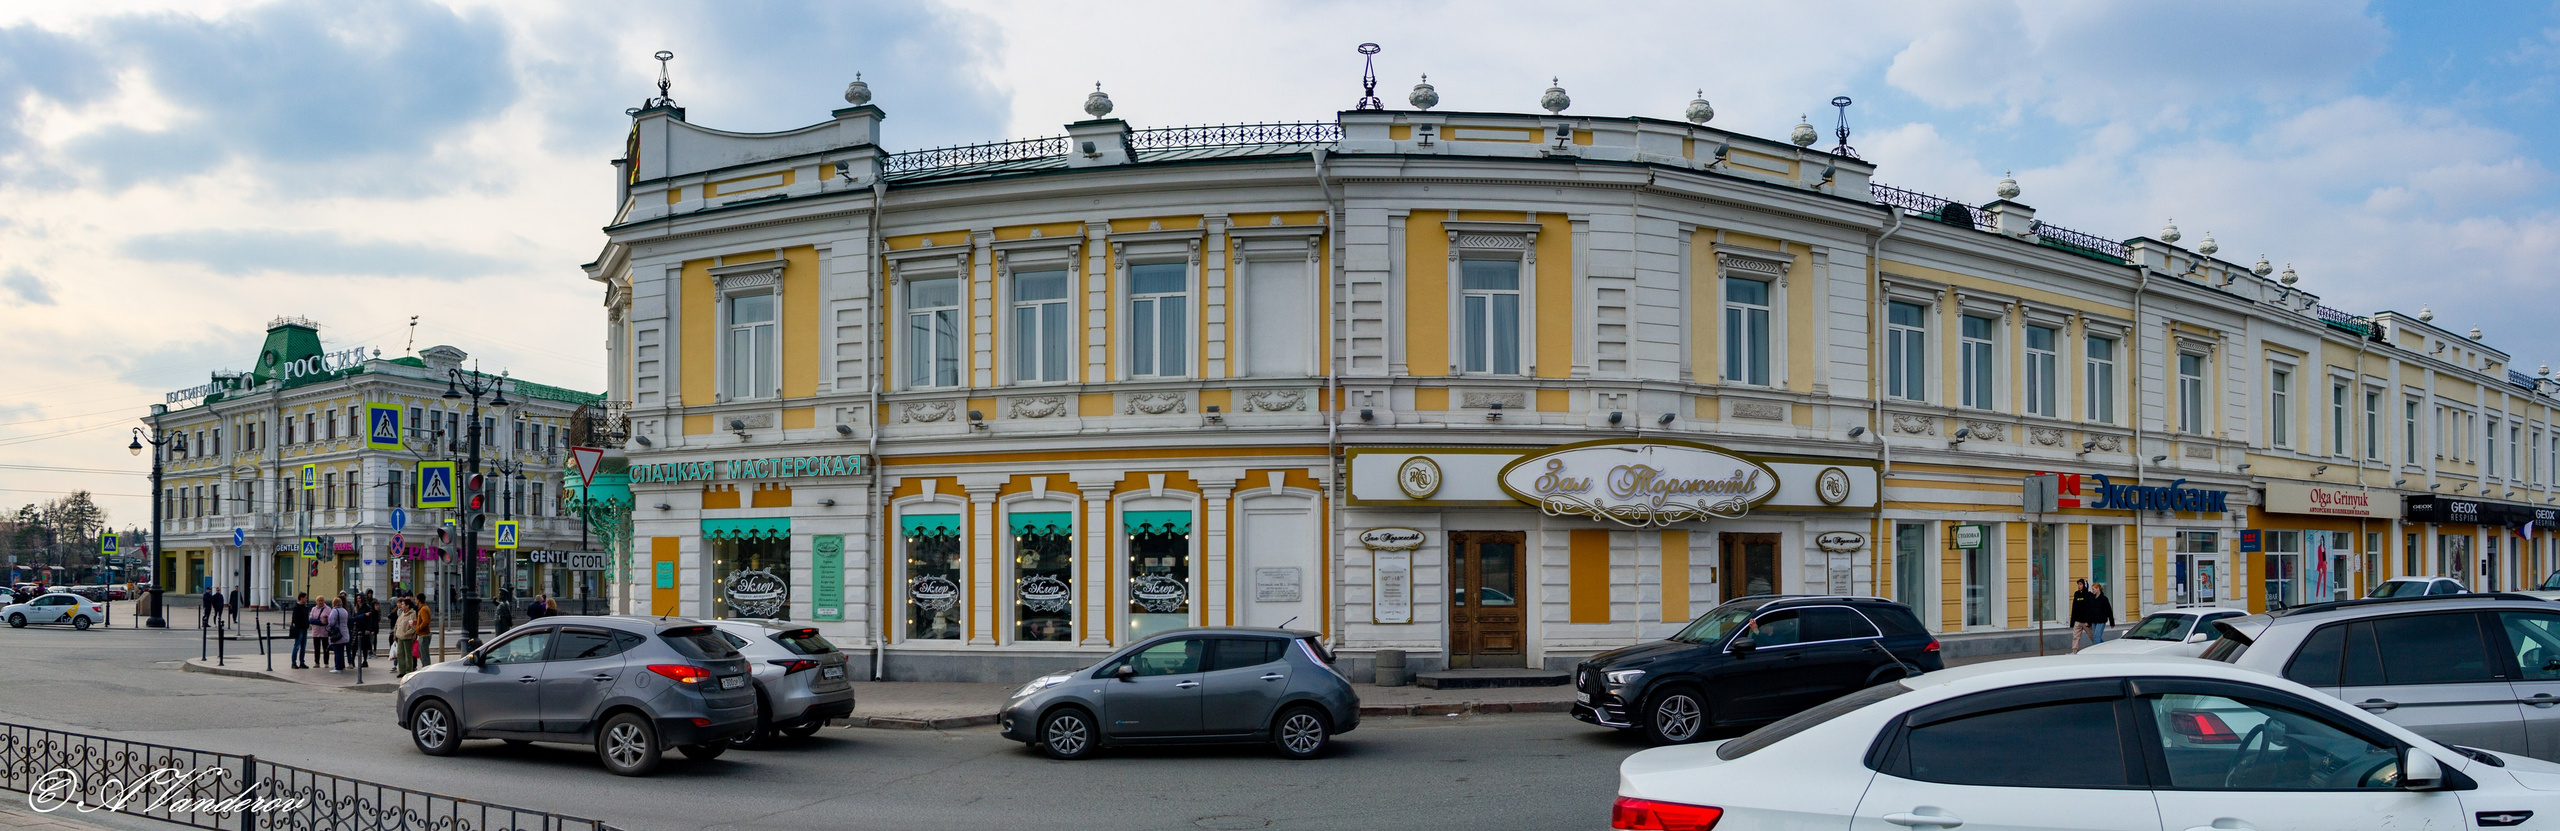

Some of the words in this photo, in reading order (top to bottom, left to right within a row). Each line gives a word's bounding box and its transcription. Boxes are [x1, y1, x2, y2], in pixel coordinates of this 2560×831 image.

[284, 346, 365, 381] РОССИЯ
[166, 380, 223, 404] ГОСТИНИЦА
[629, 461, 715, 485] СЛАДКАЯ
[727, 455, 861, 479] МАСТЕРСКАЯ
[1534, 458, 1592, 492] Зал
[1607, 463, 1760, 508] Торжеств
[2091, 473, 2228, 513] Экспобанк
[2310, 488, 2332, 508] Olga
[2334, 490, 2369, 509] Grinyuk
[2451, 501, 2477, 514] GEOX
[2535, 508, 2555, 520] GEOX
[2451, 513, 2478, 522] RESPIRA
[2535, 519, 2556, 527] RESPIRA
[1364, 533, 1379, 542] Зал
[1380, 533, 1420, 543] Торжеств
[1821, 536, 1832, 544] Зал
[408, 545, 488, 562] PARE
[530, 549, 568, 563] GENTL
[572, 554, 603, 568] СТОП
[737, 576, 774, 594] Эклер
[920, 580, 949, 594] Эклер
[1028, 580, 1059, 595] Эклер
[1142, 580, 1175, 595] Эклер
